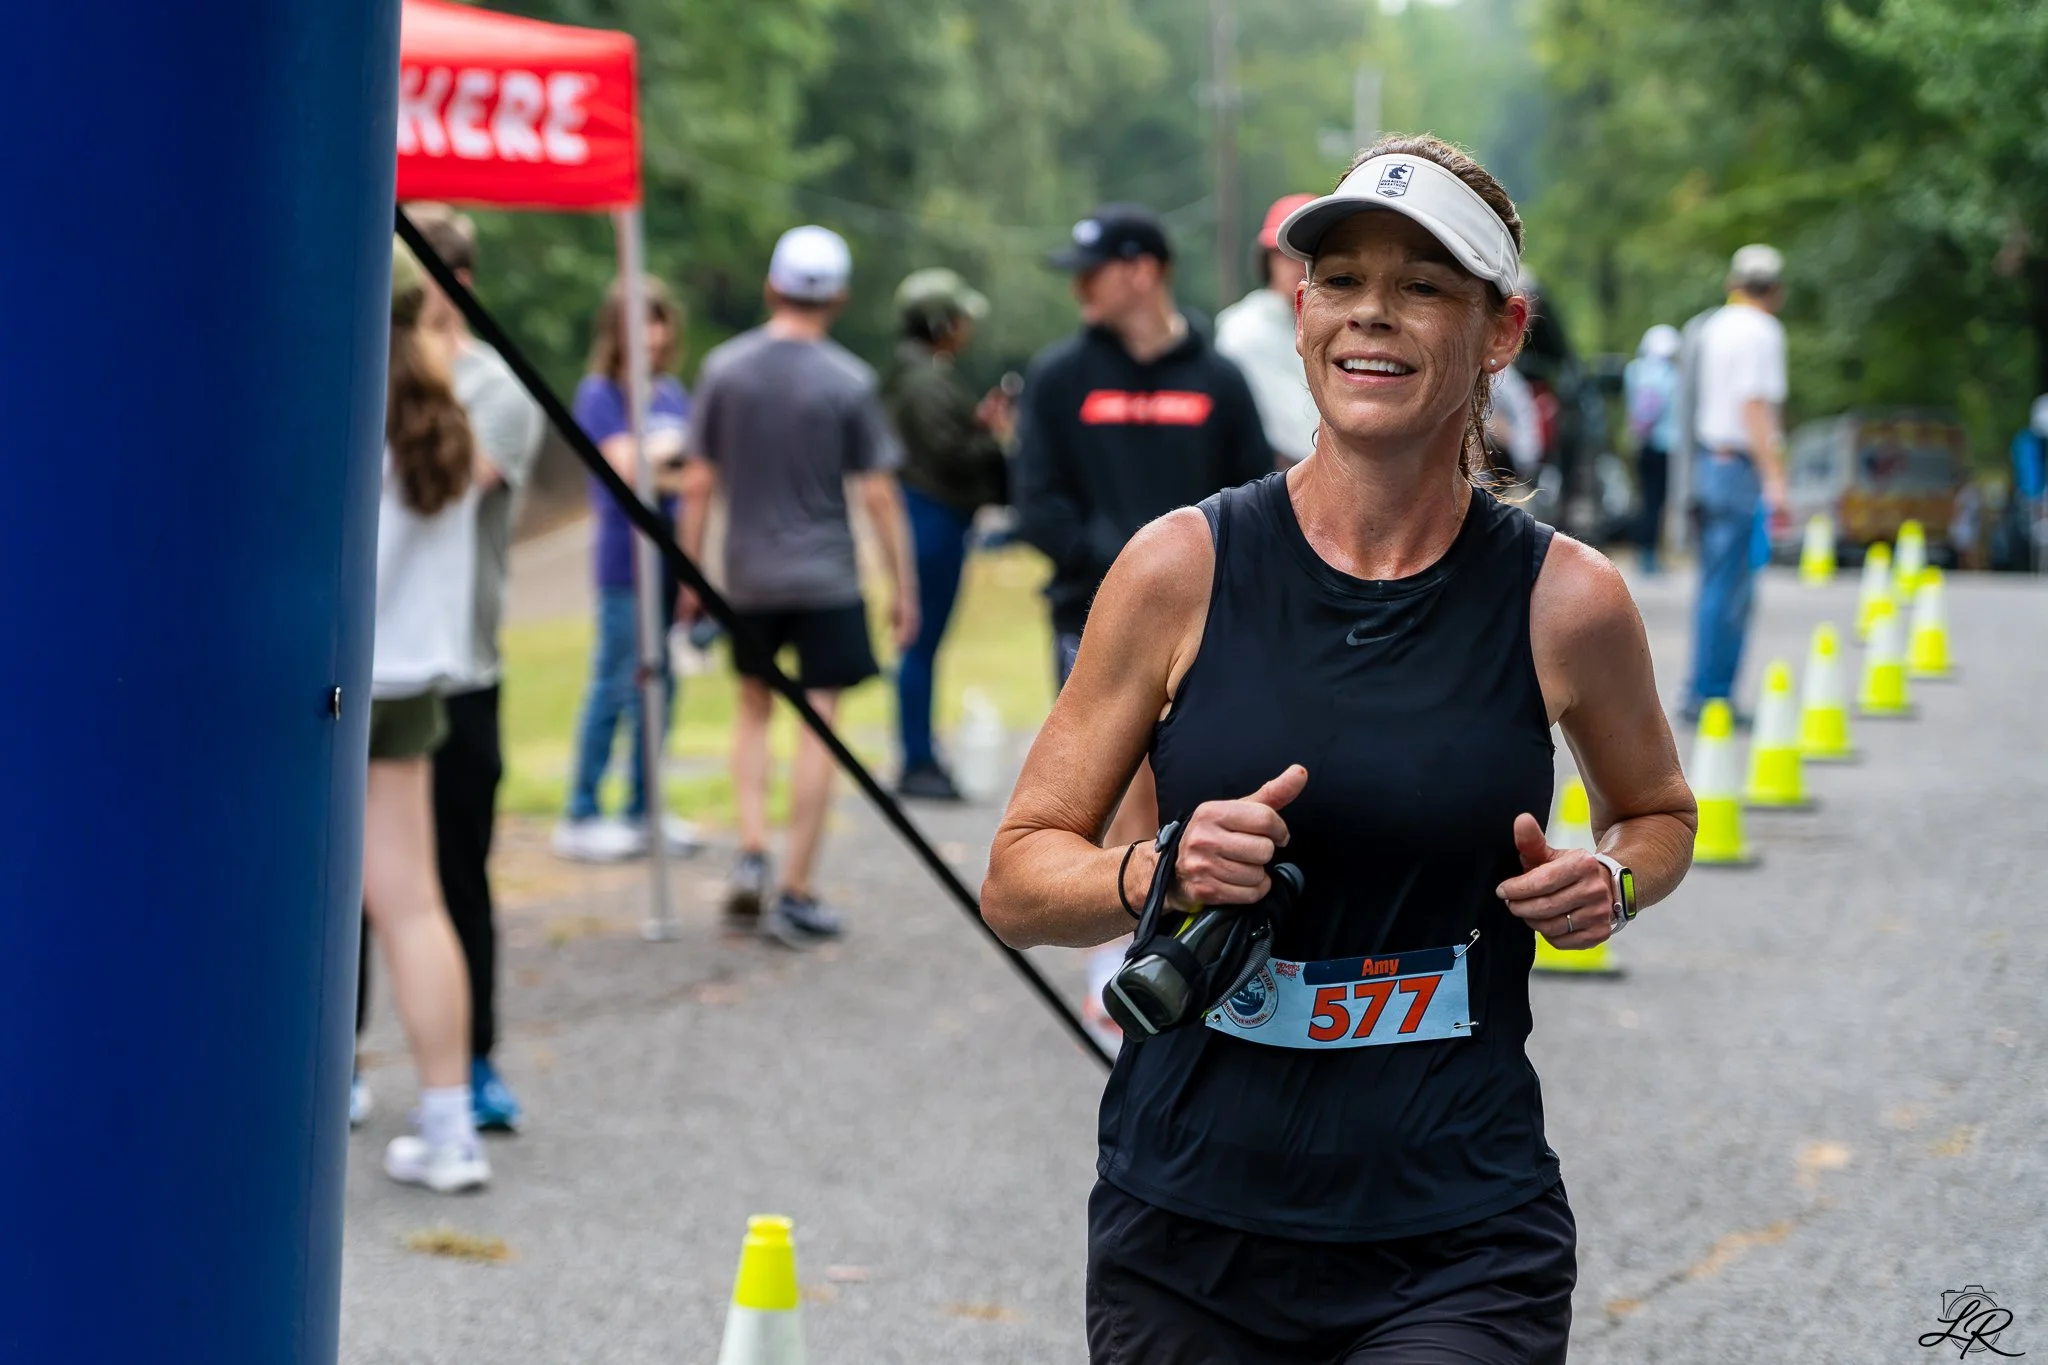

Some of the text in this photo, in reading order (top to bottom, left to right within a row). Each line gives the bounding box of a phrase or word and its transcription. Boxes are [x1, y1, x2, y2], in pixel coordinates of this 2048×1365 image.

[397, 65, 597, 166] HERE
[1361, 957, 1400, 977] Amy
[1307, 974, 1444, 1042] 577
